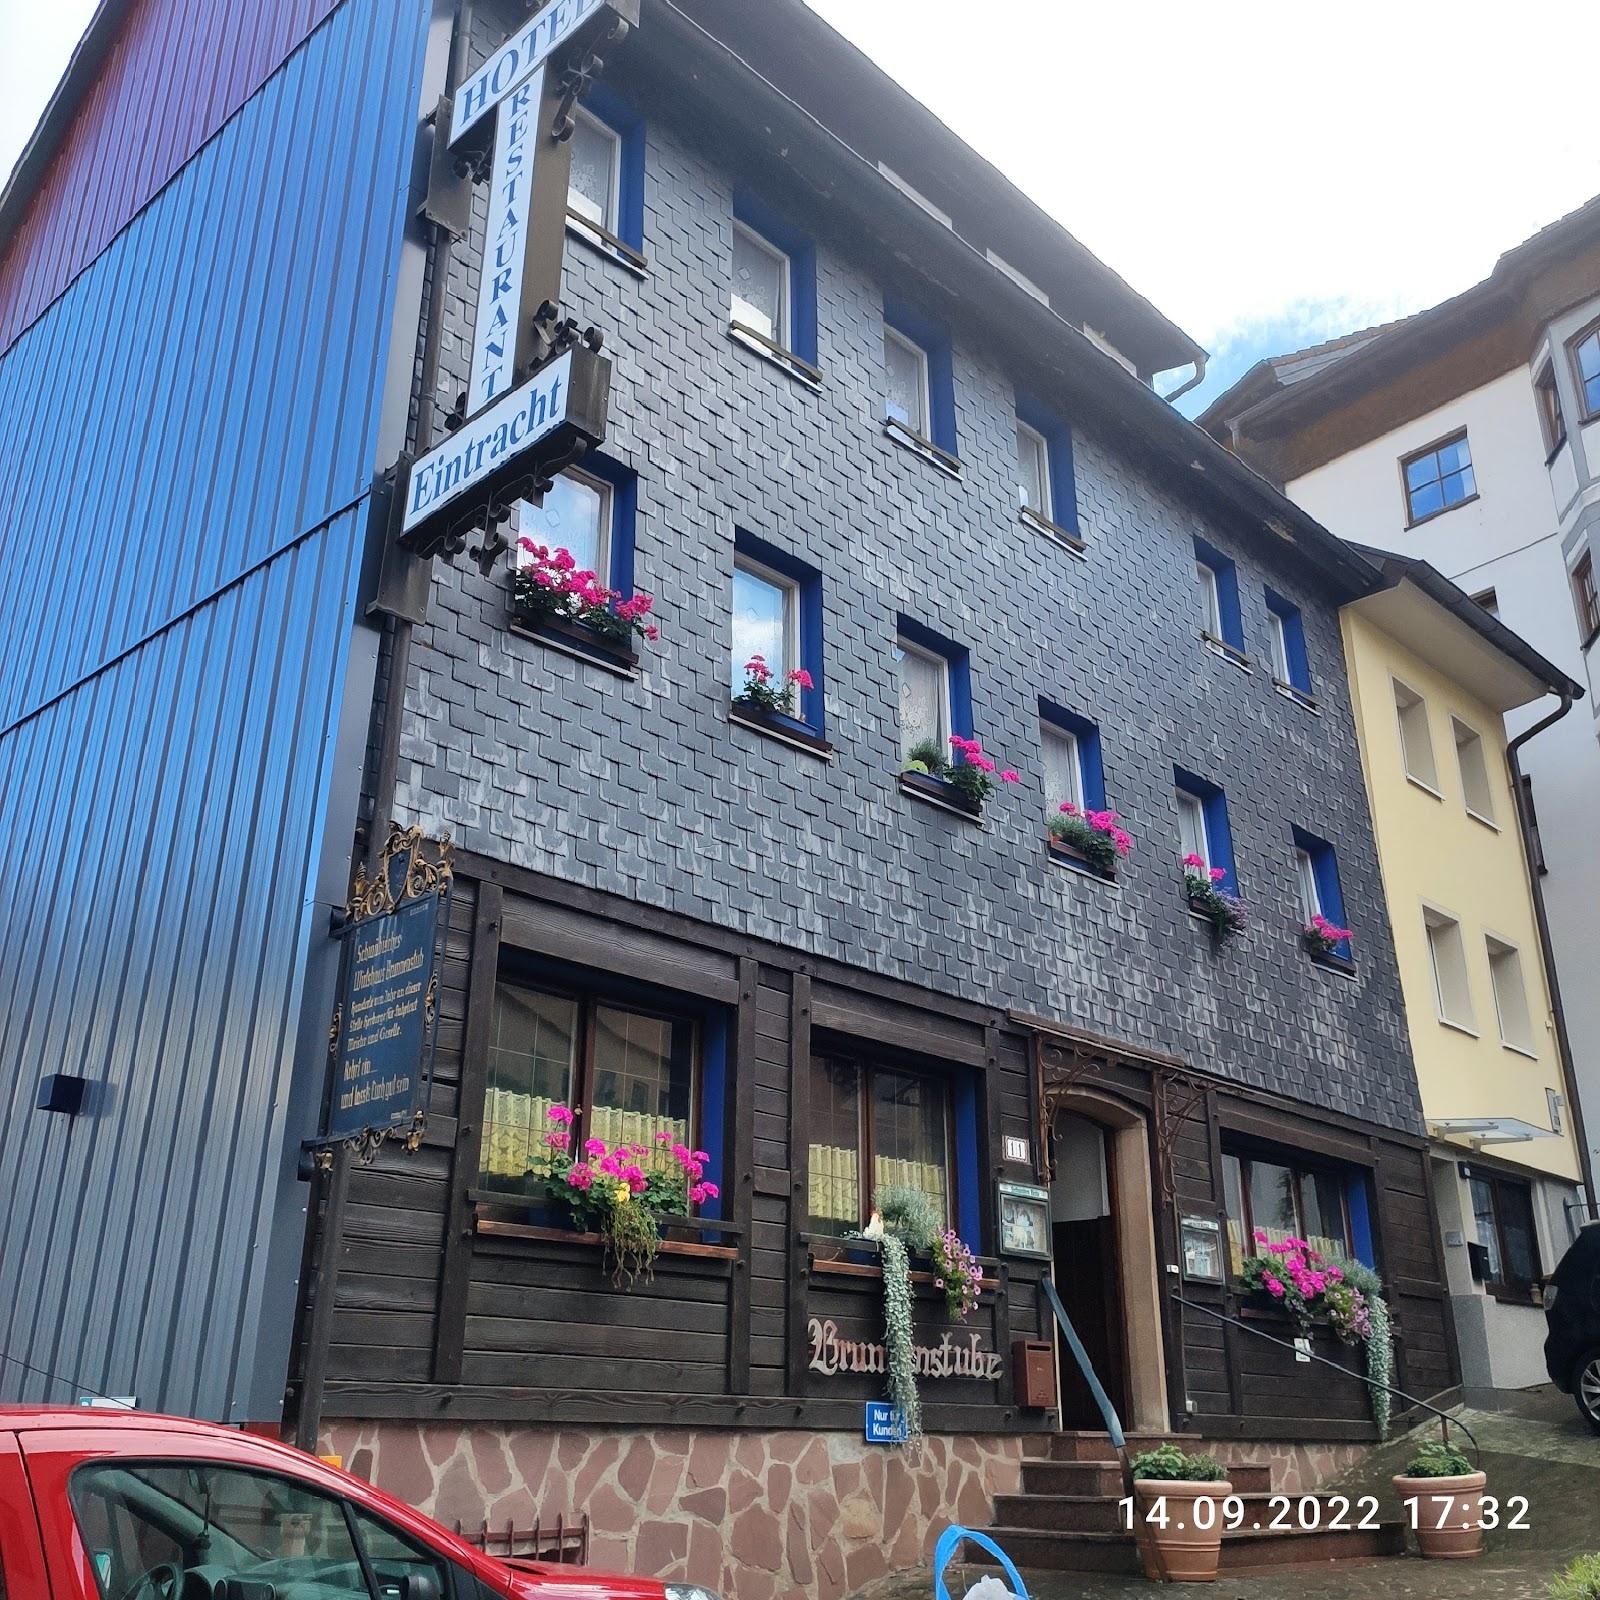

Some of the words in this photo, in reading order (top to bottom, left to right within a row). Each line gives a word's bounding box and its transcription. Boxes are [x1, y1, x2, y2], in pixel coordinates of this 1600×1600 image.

[459, 0, 597, 127] HOTEL
[481, 83, 531, 403] RESTAURANT
[409, 373, 563, 516] Eintracht
[1010, 1140, 1022, 1158] 11
[807, 1317, 1004, 1381] Brunnstube
[873, 1409, 888, 1421] Nur
